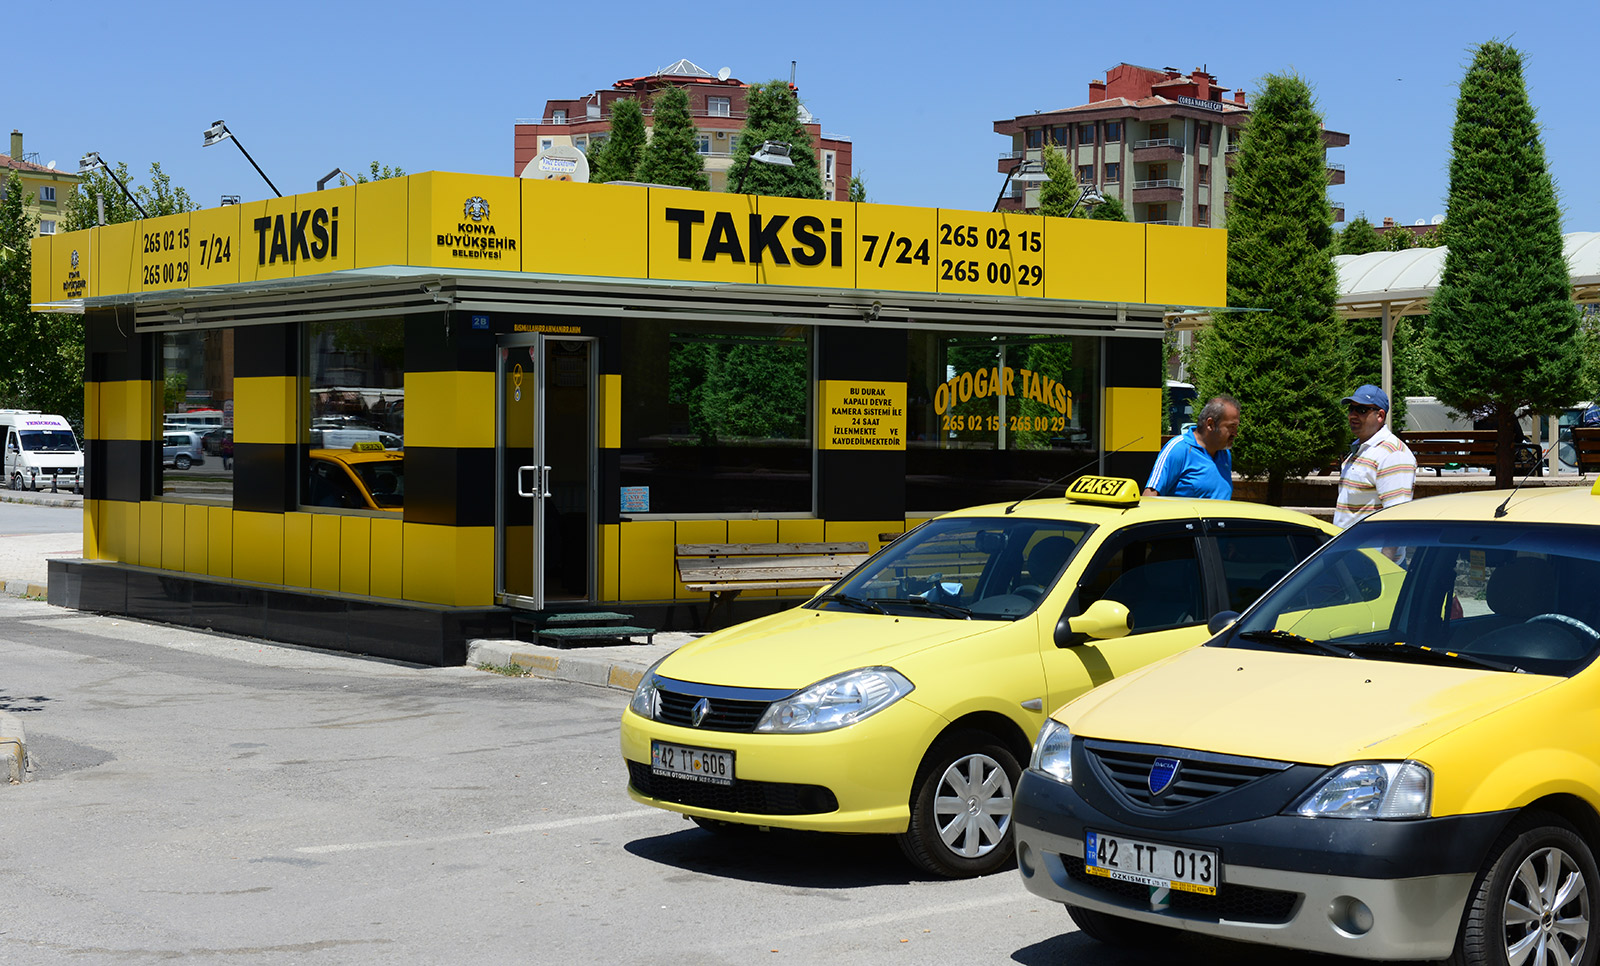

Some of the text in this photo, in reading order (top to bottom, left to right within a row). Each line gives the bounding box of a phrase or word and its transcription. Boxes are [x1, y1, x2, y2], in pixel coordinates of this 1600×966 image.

[458, 223, 496, 235] KONYA
[144, 227, 190, 253] 265 02 15
[437, 233, 516, 251] BÜYÜKŞEHİR
[940, 224, 1042, 253] 265 02 15
[200, 233, 231, 270] 7/24
[452, 249, 501, 259] BELEDİYESİ
[862, 231, 930, 268] 7/24
[144, 261, 189, 285] 265 00 29
[941, 259, 1043, 286] 265 00 29
[861, 388, 886, 396] DURAK
[934, 367, 1015, 416] OTOGAR
[892, 407, 902, 416] İLE
[834, 426, 898, 436] İZLENMEKTE VE
[862, 418, 880, 426] SAAT
[942, 415, 965, 431] 265
[968, 415, 982, 431] 02
[986, 416, 999, 431] 15
[1010, 416, 1031, 432] 265
[1034, 416, 1048, 432] 00
[1051, 417, 1065, 432] 29
[832, 437, 900, 446] KAYDEDİLMEKTEDİR
[661, 747, 725, 776] 42 TT 606
[1088, 851, 1096, 859] TR
[1097, 838, 1212, 882] 42 TT 013
